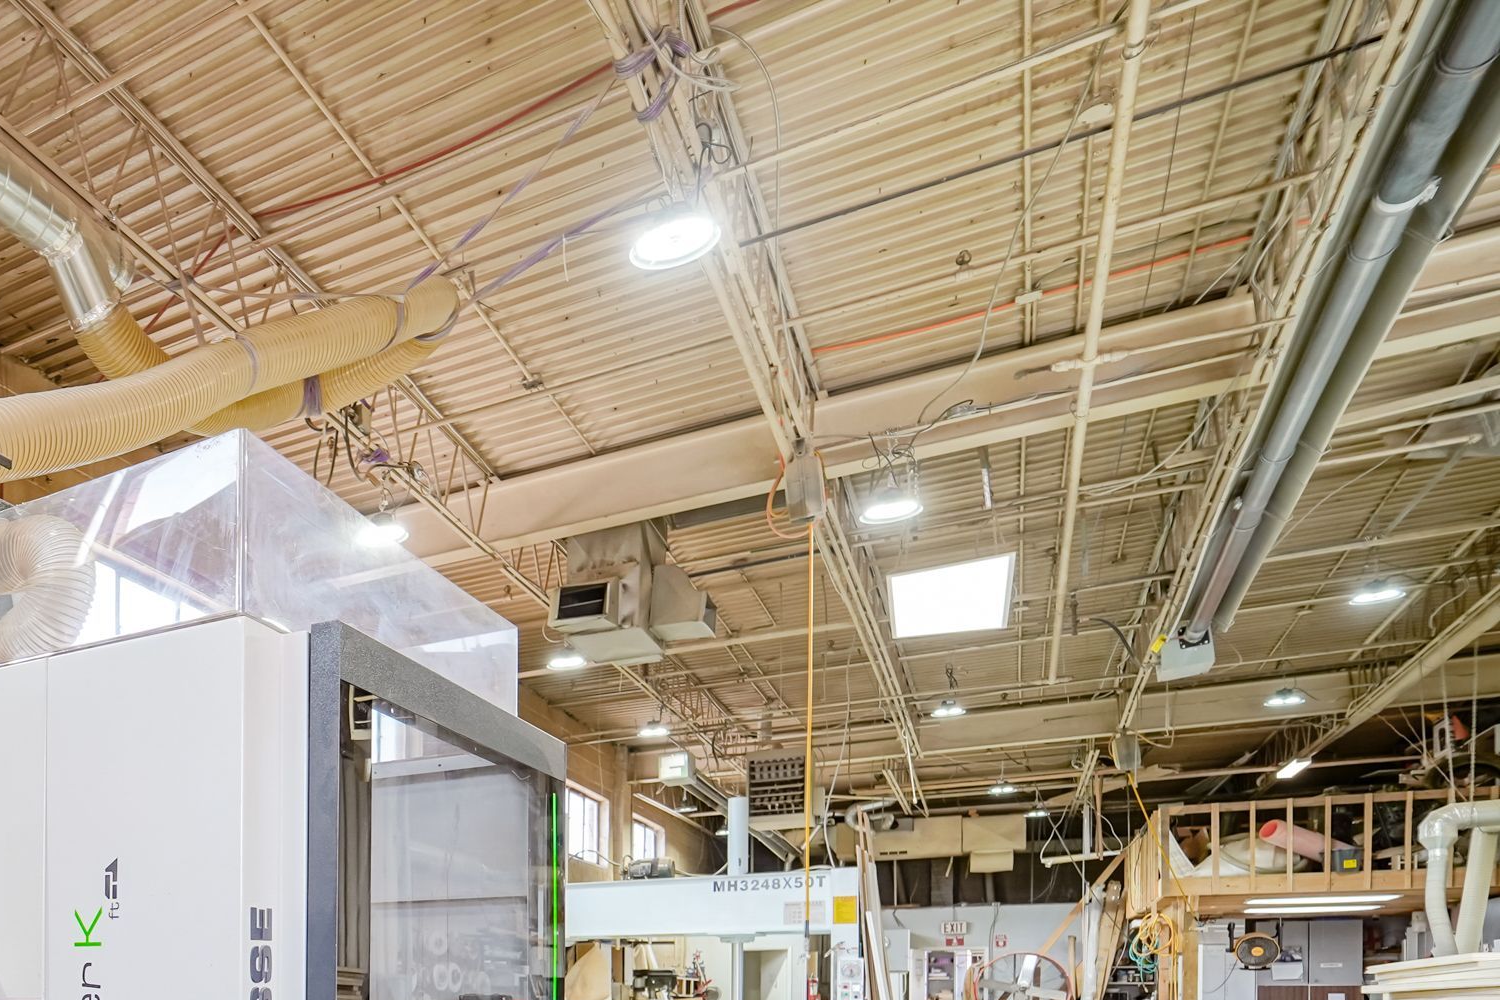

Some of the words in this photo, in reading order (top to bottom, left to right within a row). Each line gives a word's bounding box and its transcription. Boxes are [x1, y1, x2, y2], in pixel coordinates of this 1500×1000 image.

[713, 875, 826, 893] MH3248X50T
[73, 906, 102, 947] K
[943, 922, 964, 933] EXIT
